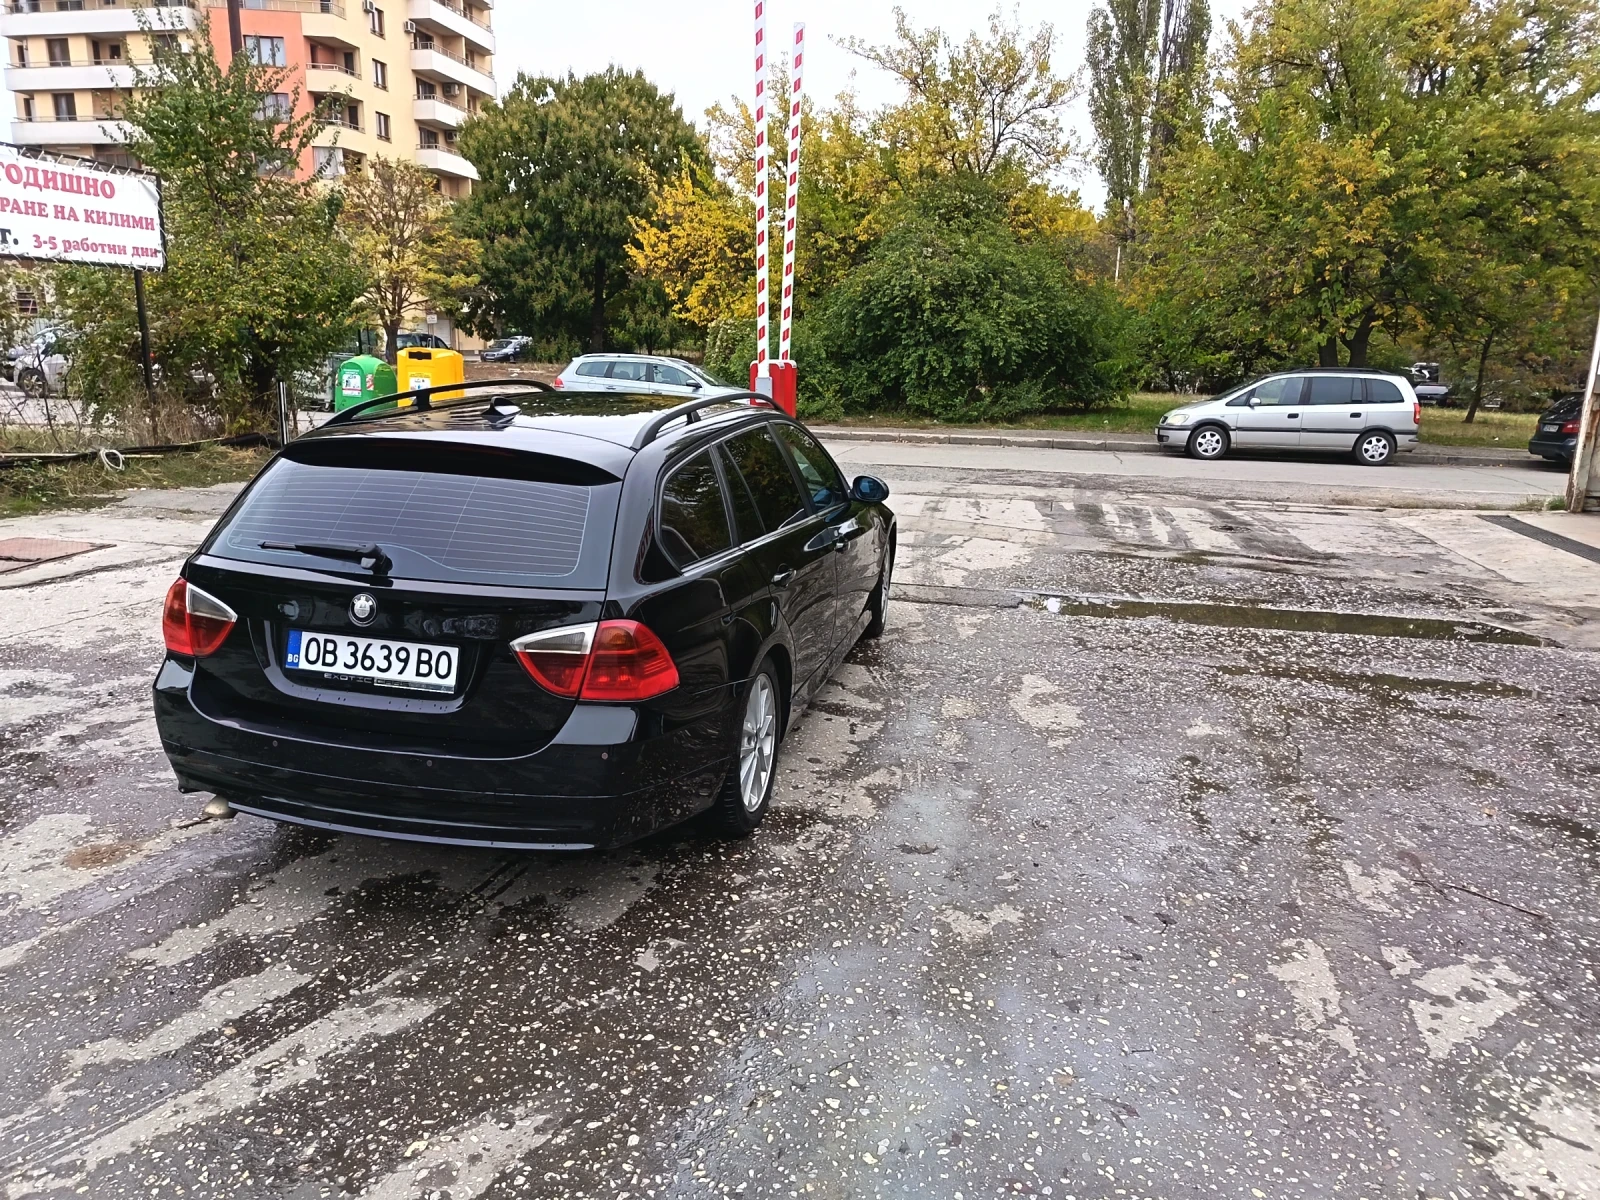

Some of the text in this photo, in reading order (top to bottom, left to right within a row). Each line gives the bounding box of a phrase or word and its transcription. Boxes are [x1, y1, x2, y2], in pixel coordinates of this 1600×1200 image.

[53, 205, 79, 222] НА
[84, 209, 155, 231] КИЛИМИ
[32, 234, 57, 250] 3-5
[62, 237, 127, 255] работни
[131, 246, 158, 258] дни
[287, 653, 298, 662] BG
[304, 637, 453, 680] OB 3639 BO
[323, 672, 372, 684] EXOTIC
